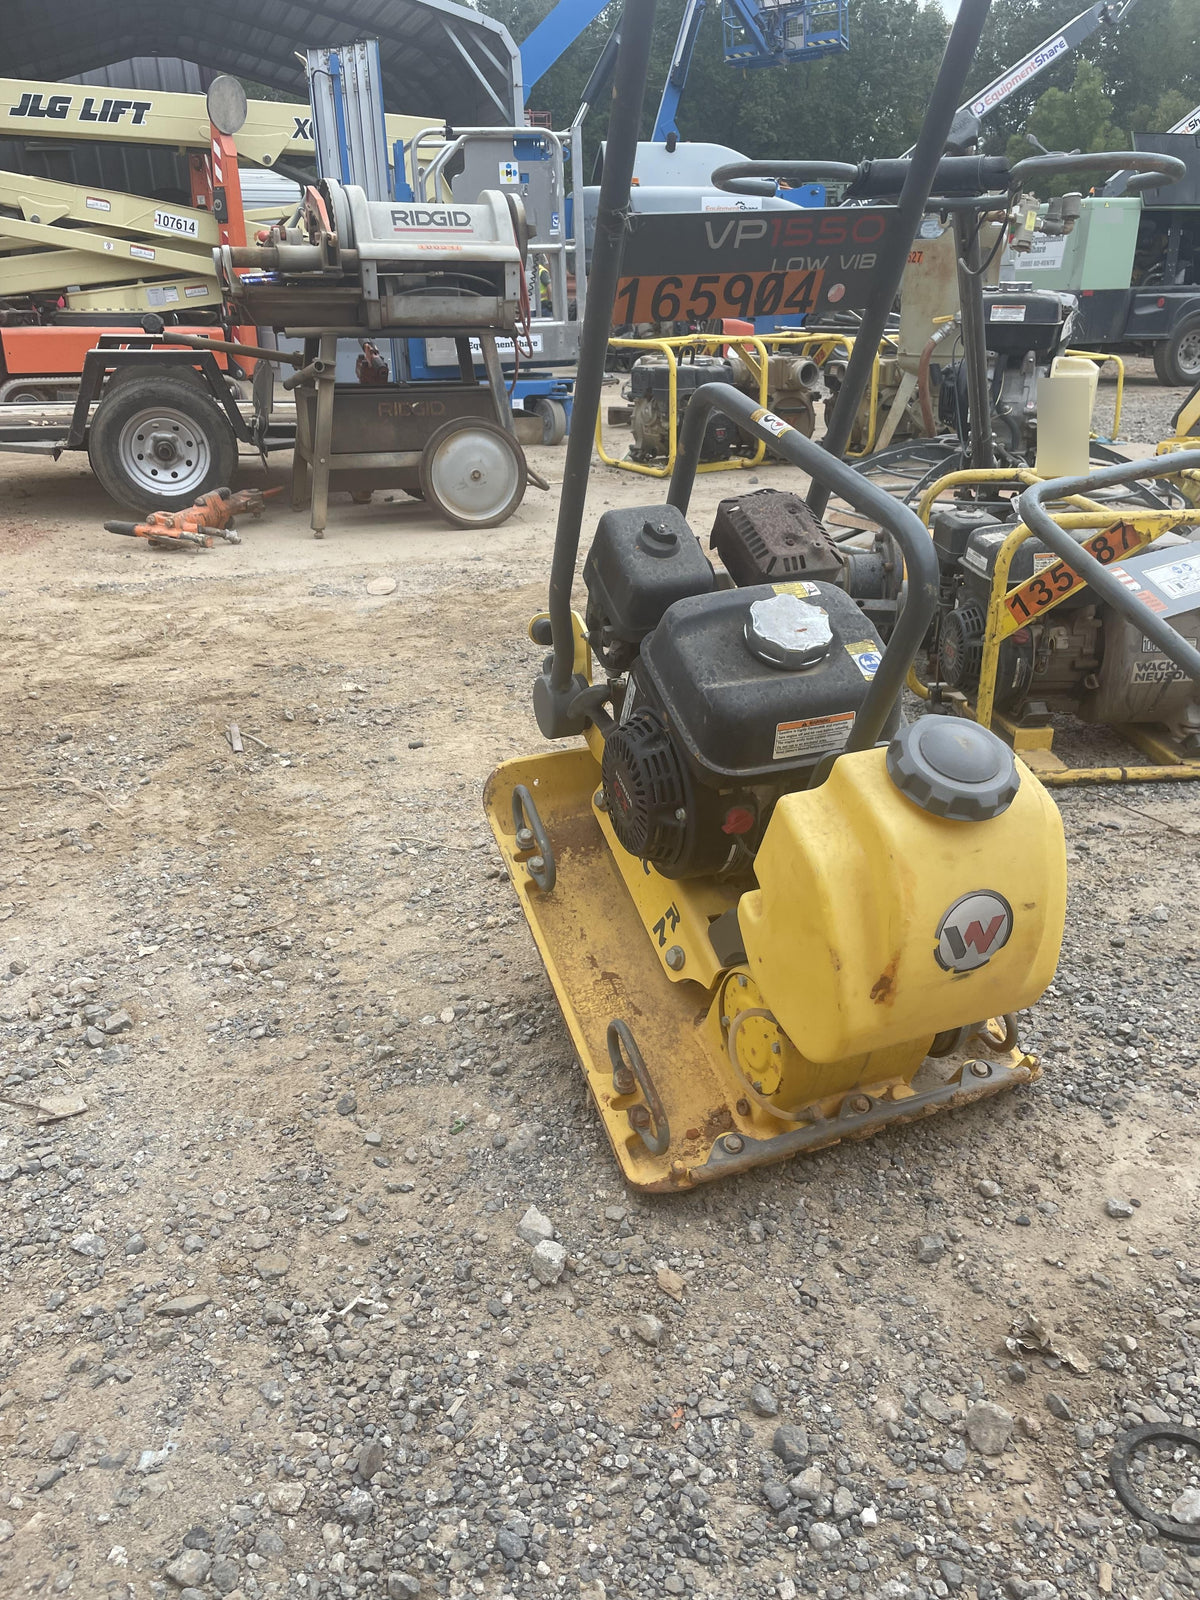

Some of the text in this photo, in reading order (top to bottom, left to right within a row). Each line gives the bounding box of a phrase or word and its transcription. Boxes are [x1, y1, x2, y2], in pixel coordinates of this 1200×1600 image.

[984, 40, 1066, 105] EquipmentShare
[9, 93, 152, 124] JLG LIFT
[157, 213, 196, 234] 107614
[390, 210, 472, 227] RIDGID
[704, 215, 886, 249] VP1550
[771, 253, 877, 273] LOW VIB
[1011, 521, 1130, 617] 13587
[1136, 661, 1177, 672] WACK
